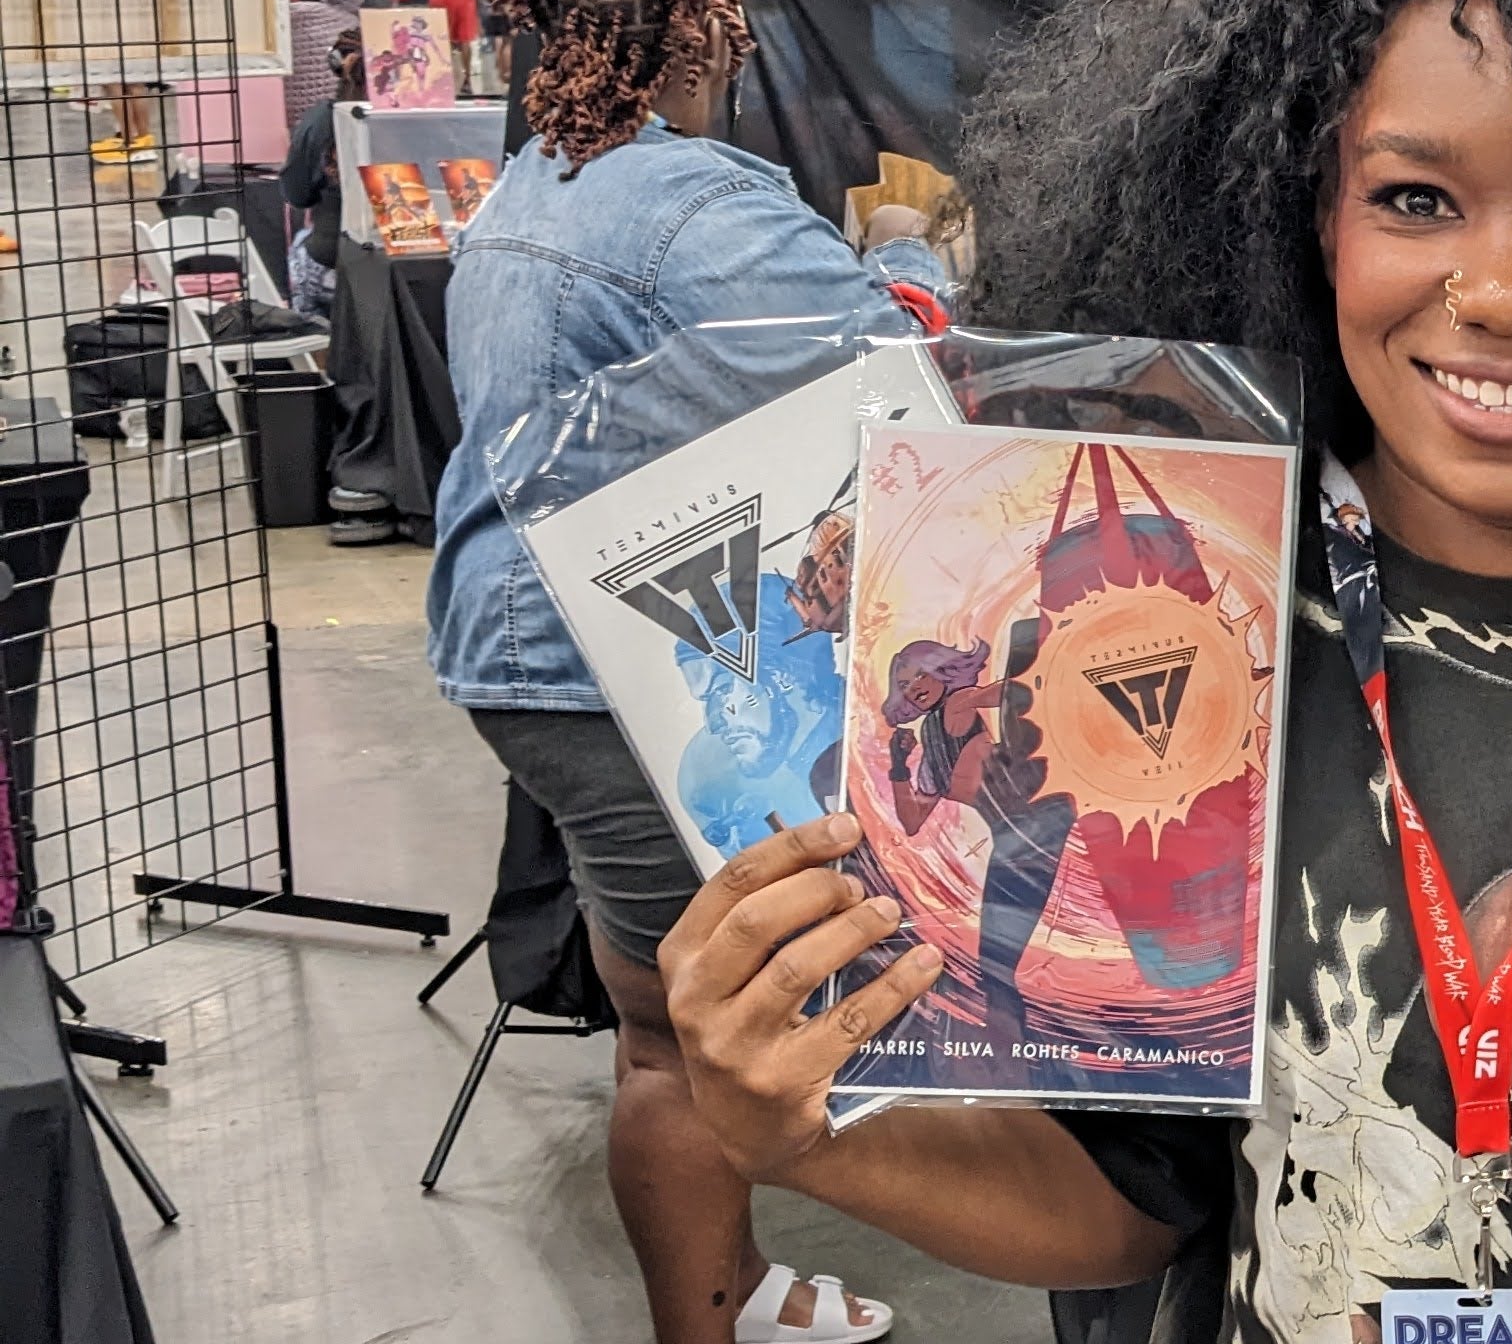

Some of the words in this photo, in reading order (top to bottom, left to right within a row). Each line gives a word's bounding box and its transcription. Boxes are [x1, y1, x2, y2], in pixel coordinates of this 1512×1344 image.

[860, 1040, 926, 1056] HARRIS
[943, 1041, 994, 1057] SILVA
[1012, 1043, 1080, 1060] ROHLFS
[1097, 1046, 1224, 1066] CARAMANICO
[1474, 1029, 1499, 1079] VIZ
